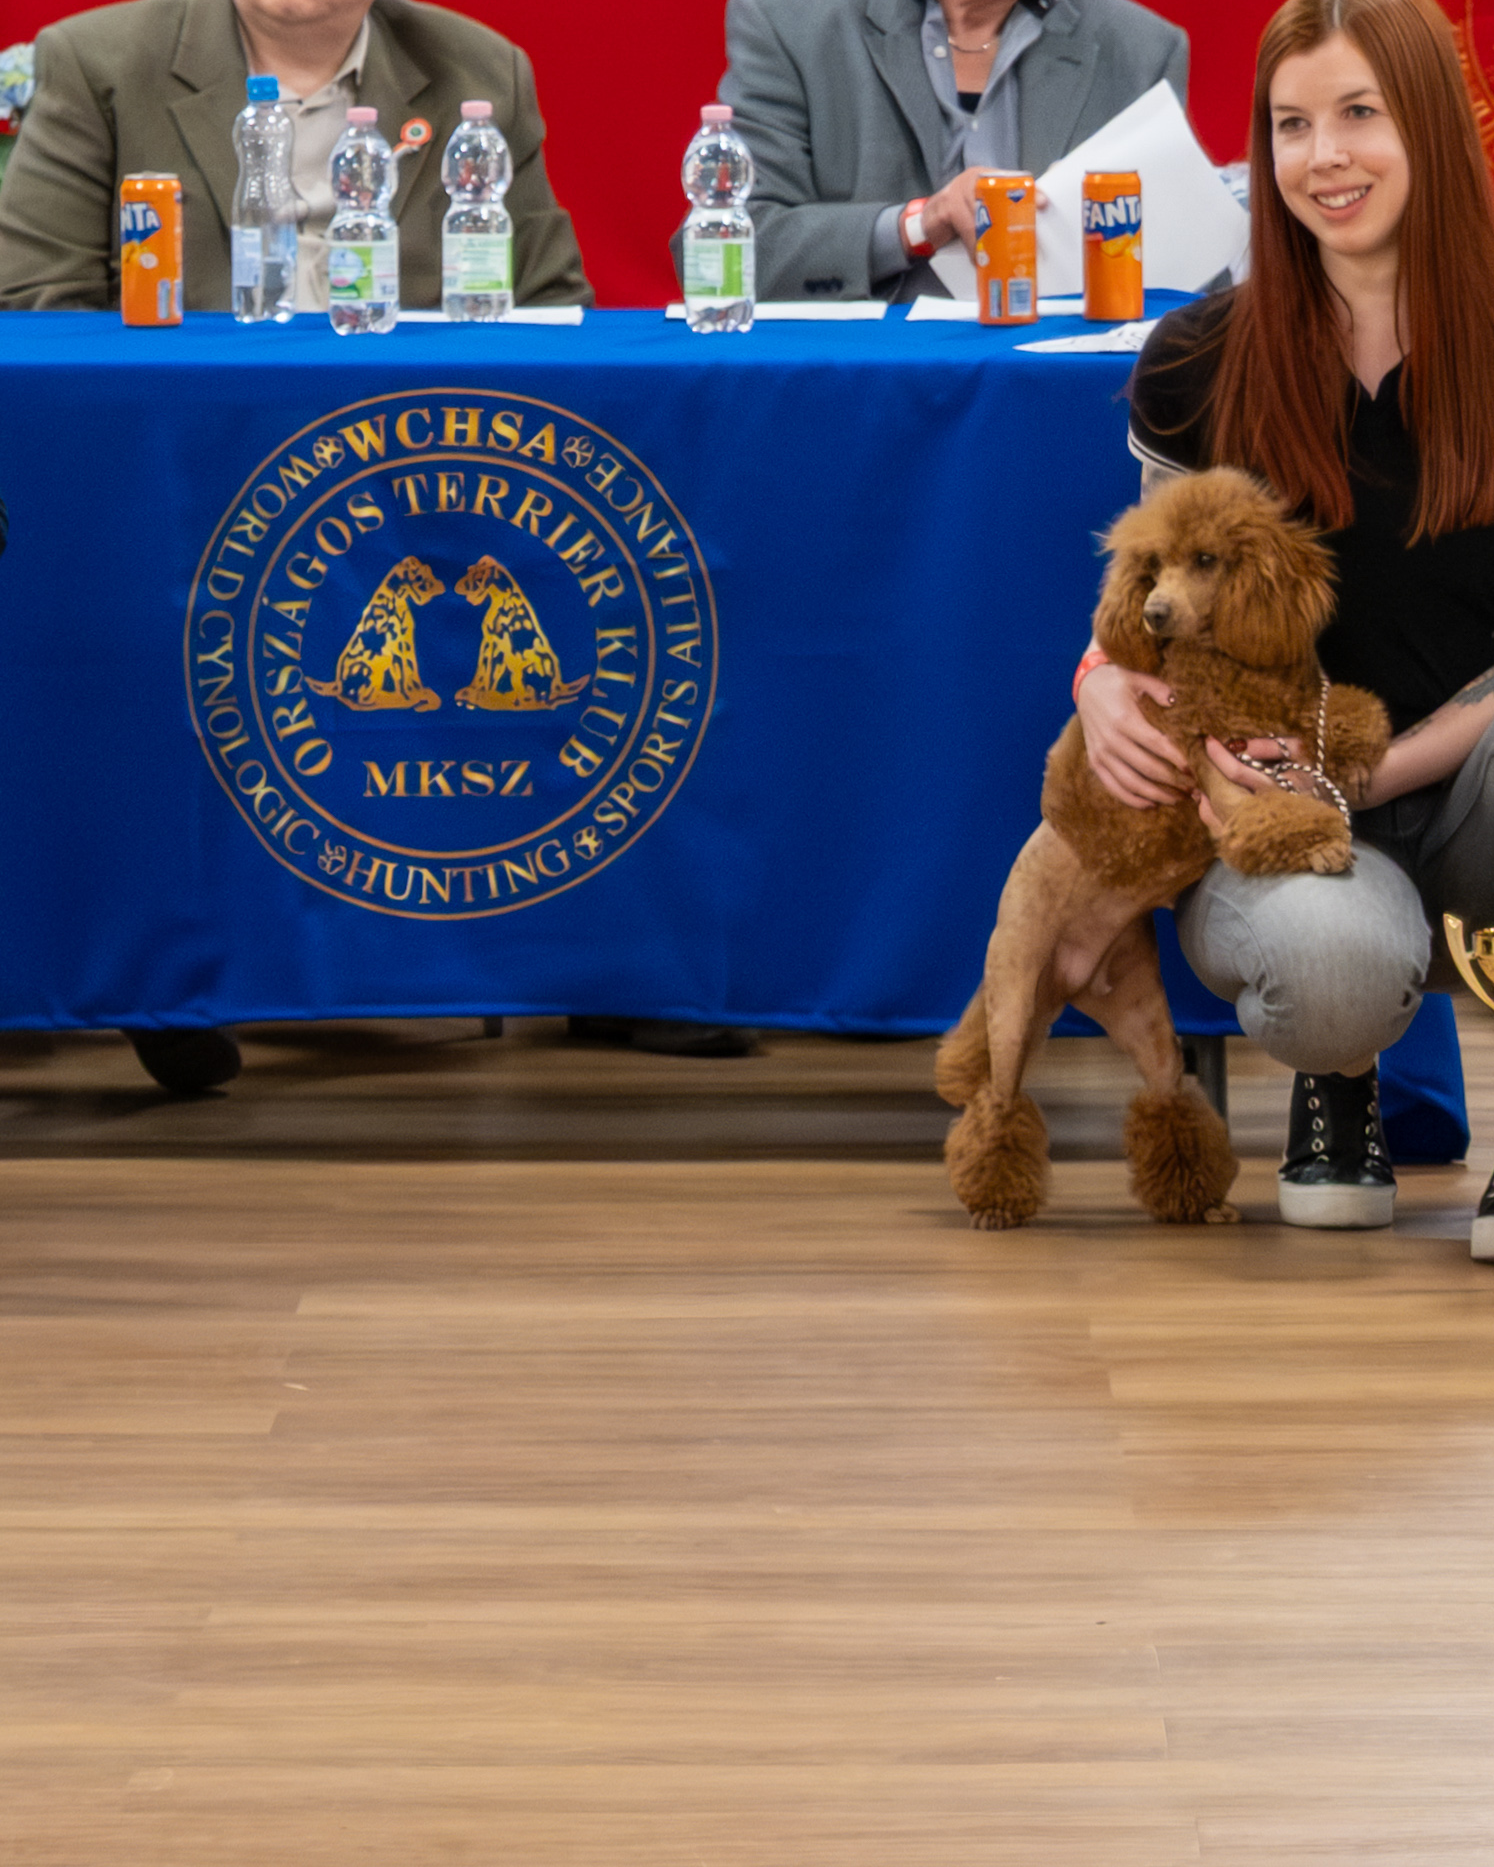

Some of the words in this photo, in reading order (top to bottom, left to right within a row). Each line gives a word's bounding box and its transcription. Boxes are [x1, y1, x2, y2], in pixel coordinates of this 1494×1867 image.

[120, 202, 160, 232] NTA
[337, 407, 559, 465] WCHSA
[206, 453, 321, 601] WORLD
[584, 452, 702, 669] ALLIANCE
[262, 491, 385, 777] ORSZÁGOS
[392, 472, 627, 608] TERRIER
[558, 624, 640, 778] KLUB
[198, 610, 321, 856] CYNOLOGIC
[362, 760, 534, 798] MKSZ
[593, 678, 699, 836] SPORTS
[344, 839, 572, 906] HUNTING
